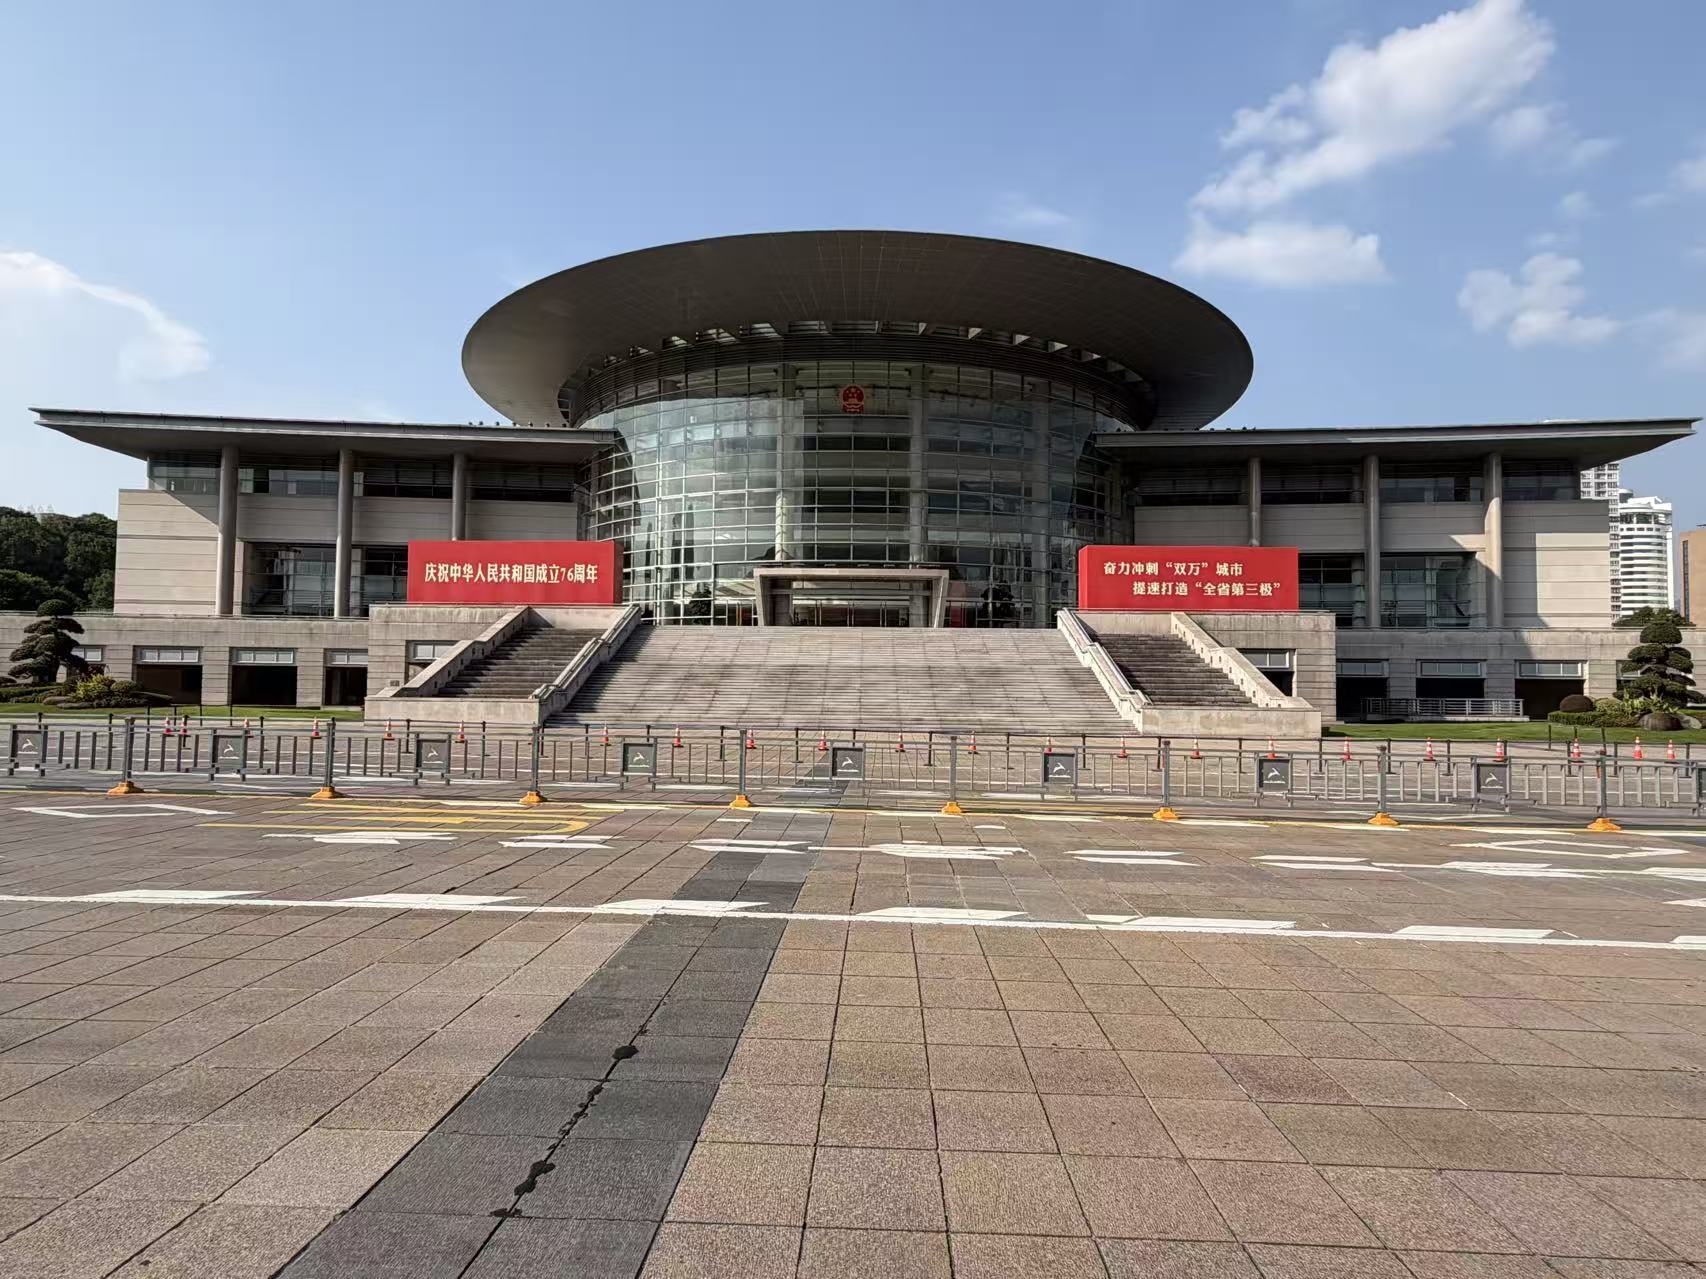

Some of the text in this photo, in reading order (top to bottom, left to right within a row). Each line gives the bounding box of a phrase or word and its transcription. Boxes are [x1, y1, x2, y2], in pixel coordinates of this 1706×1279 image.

[425, 562, 598, 584] 庆祝中华人民共和国成立76周年
[1132, 581, 1281, 597] 提速打造“全省第三极”
